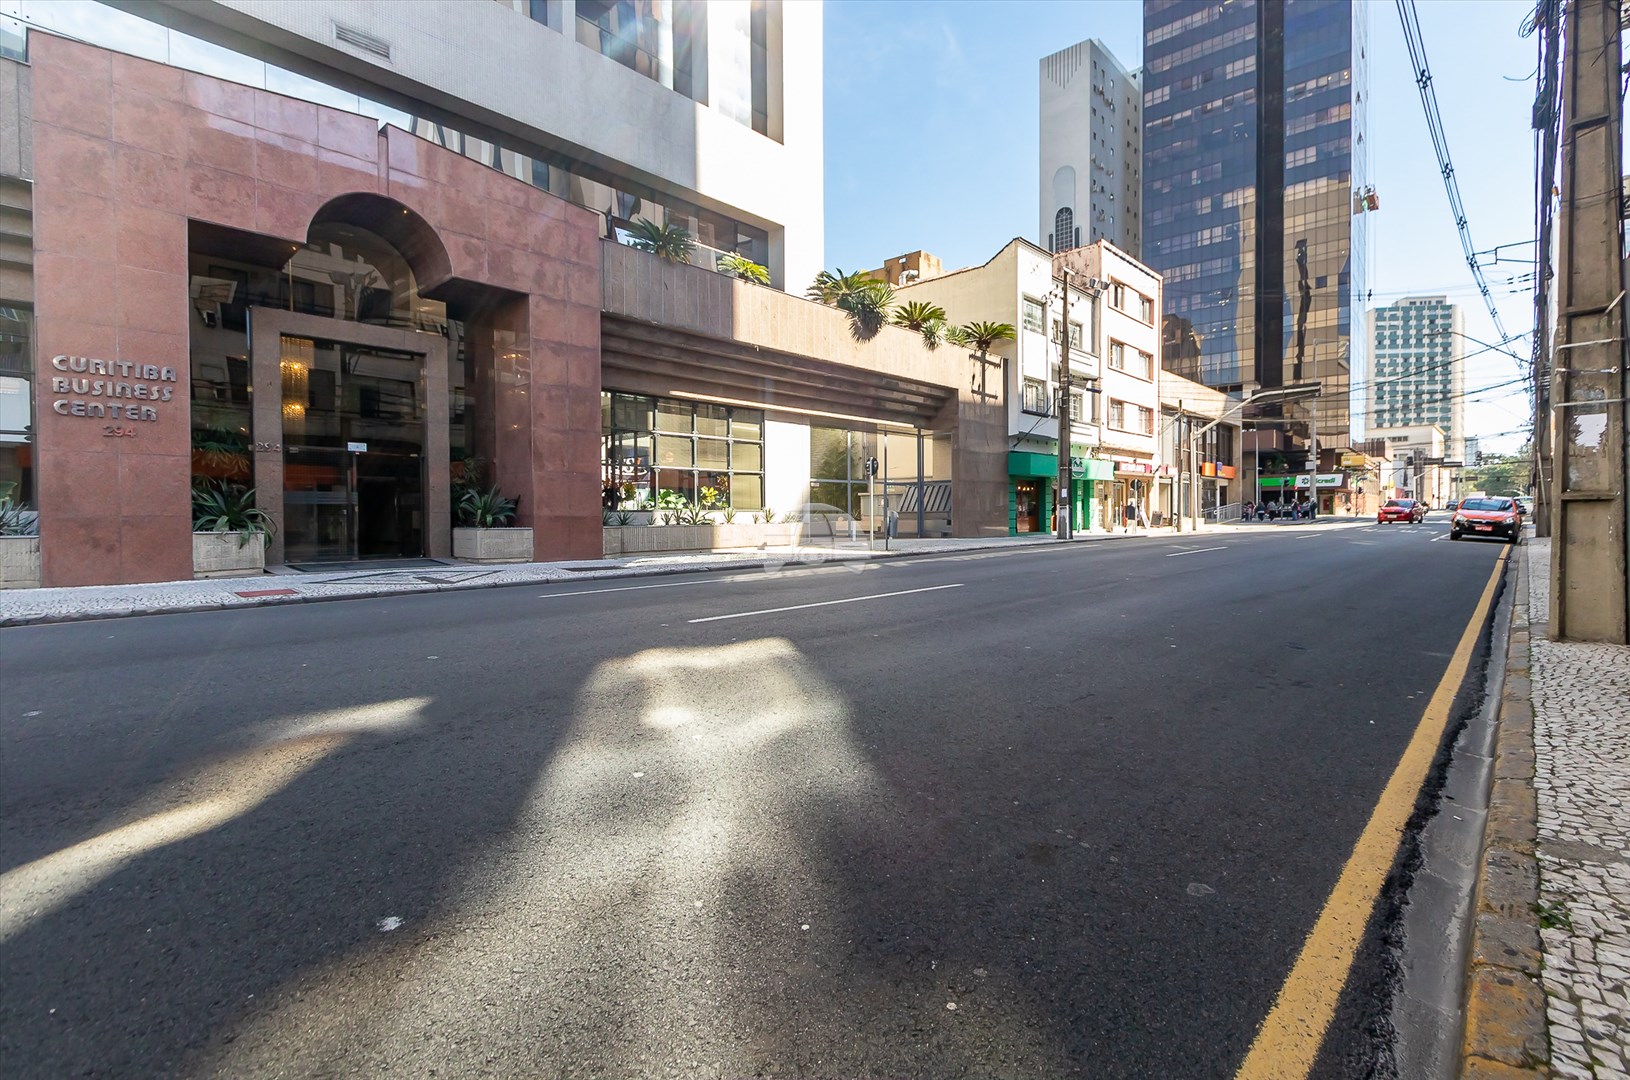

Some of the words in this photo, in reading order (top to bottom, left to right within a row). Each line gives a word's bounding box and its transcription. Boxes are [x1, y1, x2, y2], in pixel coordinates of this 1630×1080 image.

[52, 355, 177, 382] CURITIBA
[52, 376, 173, 402] BUSINESS
[53, 399, 157, 421] CENTER
[102, 424, 136, 438] 294
